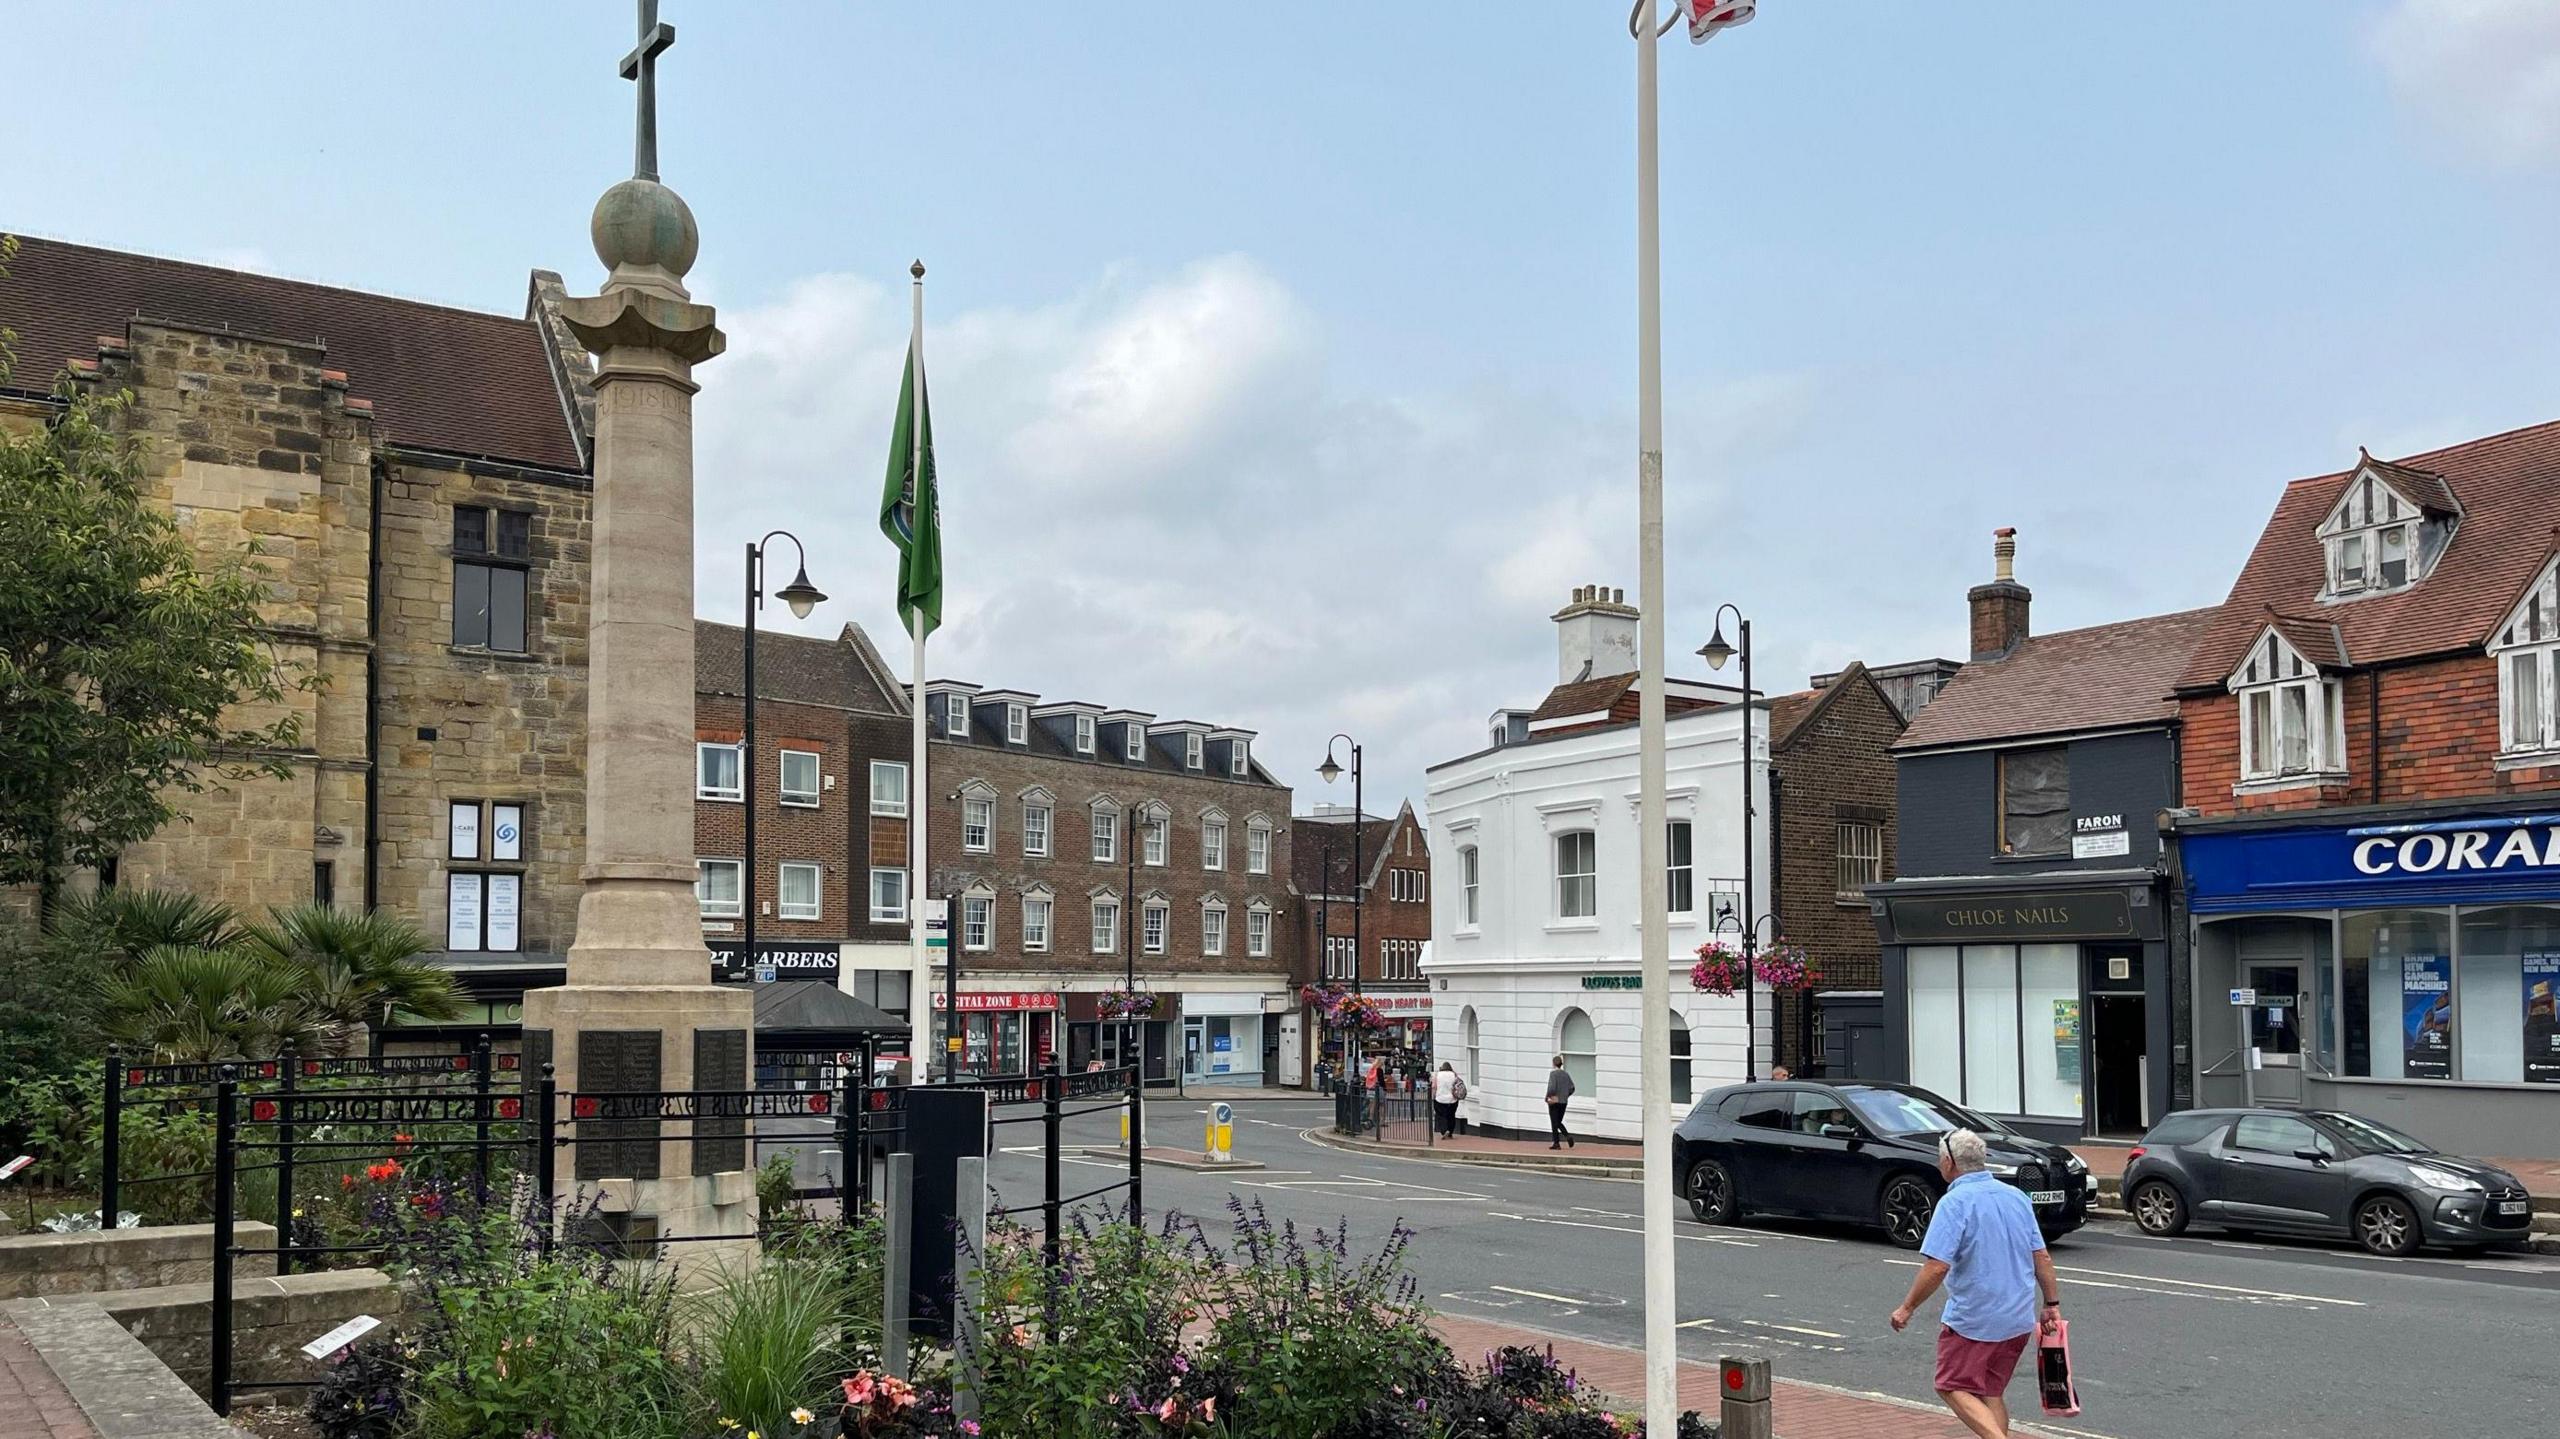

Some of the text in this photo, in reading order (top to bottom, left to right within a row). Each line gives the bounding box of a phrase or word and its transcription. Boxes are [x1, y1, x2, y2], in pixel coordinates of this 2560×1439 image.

[2077, 814, 2121, 829] FARON
[1945, 907, 2069, 926] CHLOE NAILS
[2404, 971, 2439, 981] GAMING
[1582, 976, 1642, 989] LLOYDS BAN
[2404, 980, 2448, 990] MACHINES
[986, 996, 1012, 1008] ZONE
[2032, 1193, 2051, 1202] GU22
